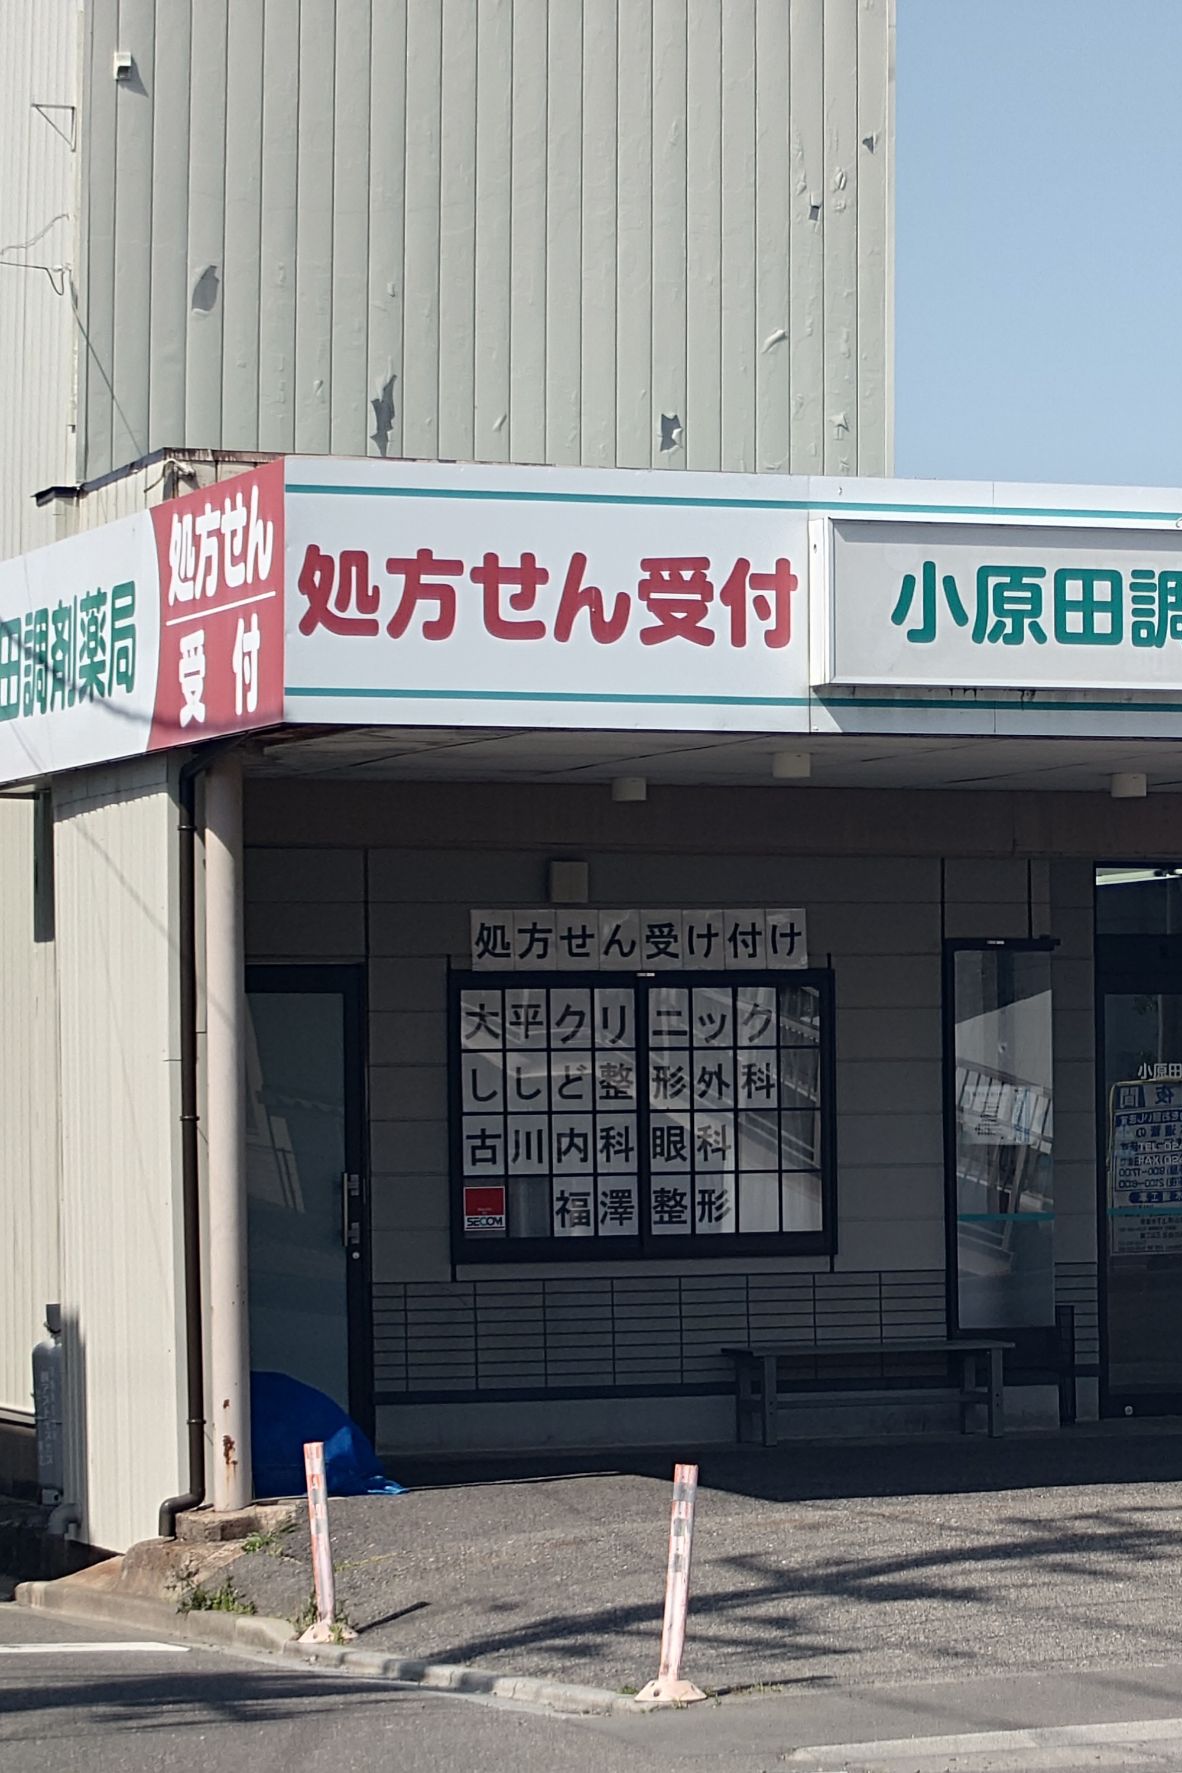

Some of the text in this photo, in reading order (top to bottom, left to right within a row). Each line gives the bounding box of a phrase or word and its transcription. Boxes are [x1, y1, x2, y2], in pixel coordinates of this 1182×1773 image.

[168, 485, 274, 606] 処方せん
[298, 544, 798, 649] 処方せん受付
[178, 613, 261, 728] 受付
[475, 921, 802, 959] 処方せん受け付け
[465, 1003, 773, 1044] 大平クリニック
[471, 1062, 775, 1102] ししど整形外科
[467, 1216, 503, 1227] SECOM
[555, 1187, 732, 1229] 福澤整形
